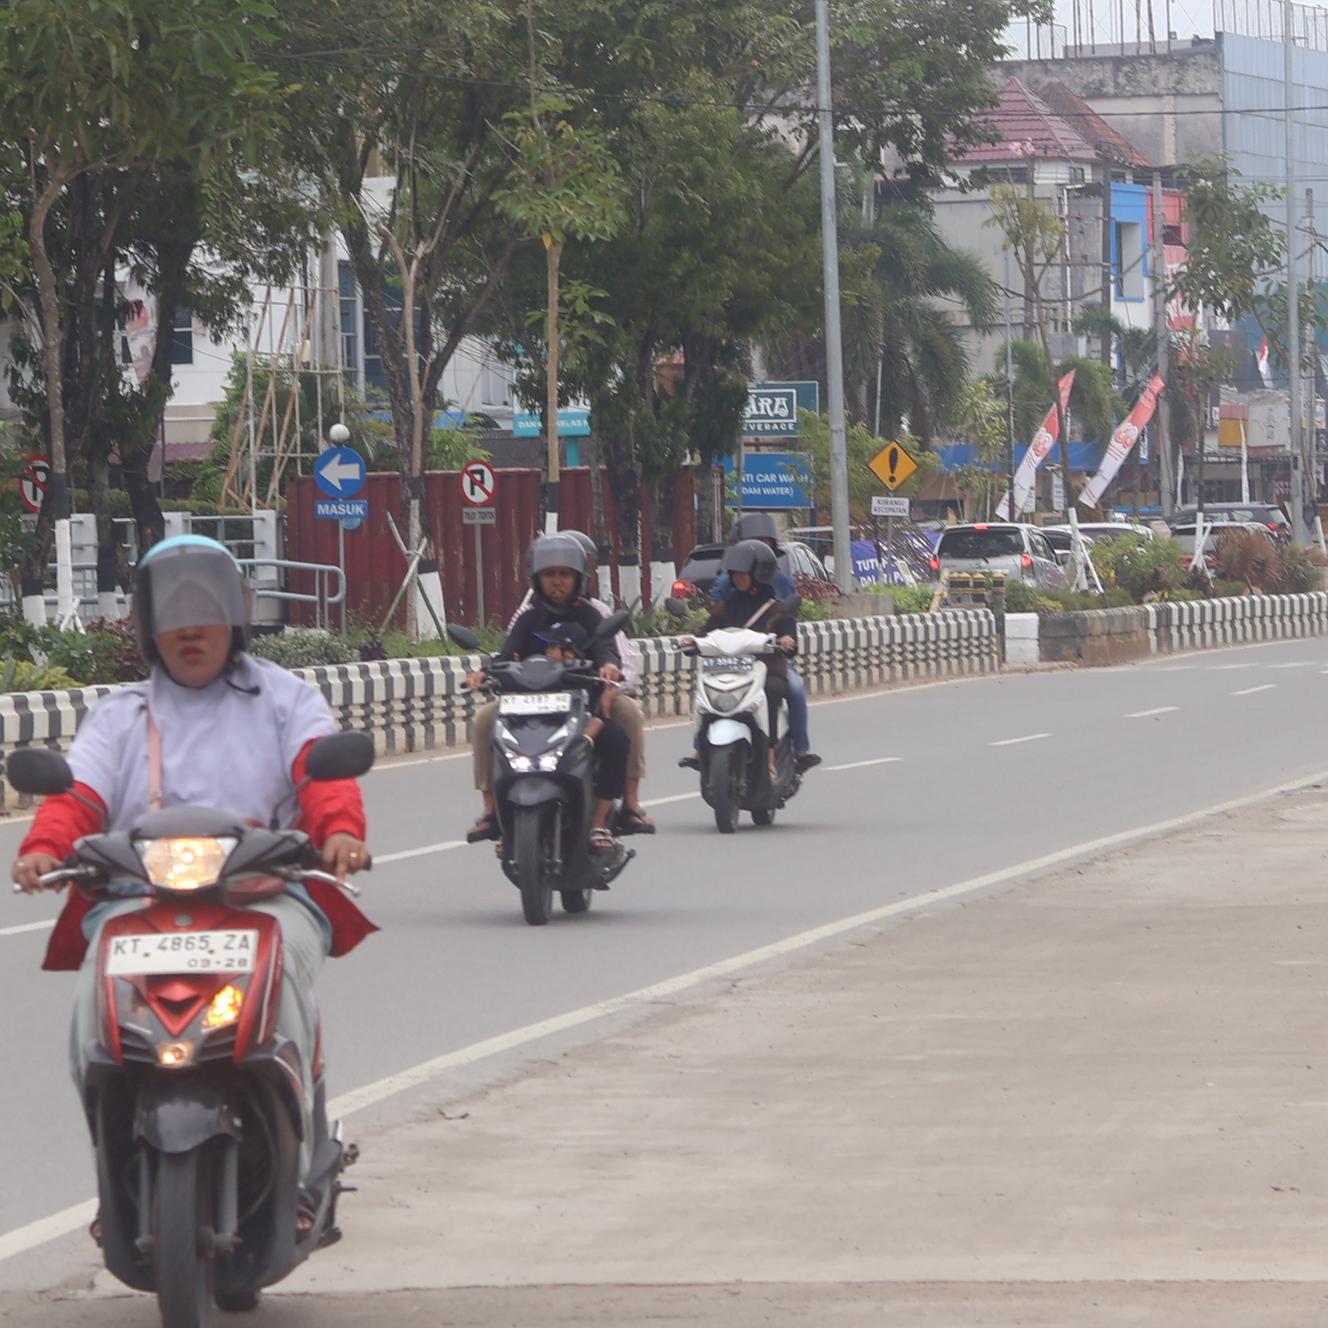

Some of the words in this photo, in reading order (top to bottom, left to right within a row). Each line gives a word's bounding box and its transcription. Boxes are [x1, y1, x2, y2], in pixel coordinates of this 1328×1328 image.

[756, 473, 777, 483] CAR
[779, 473, 809, 483] WAH
[762, 486, 794, 496] WATER)
[317, 503, 364, 516] MASUK
[114, 938, 142, 956] KT
[157, 935, 211, 952] 4865
[224, 934, 250, 951] ZA
